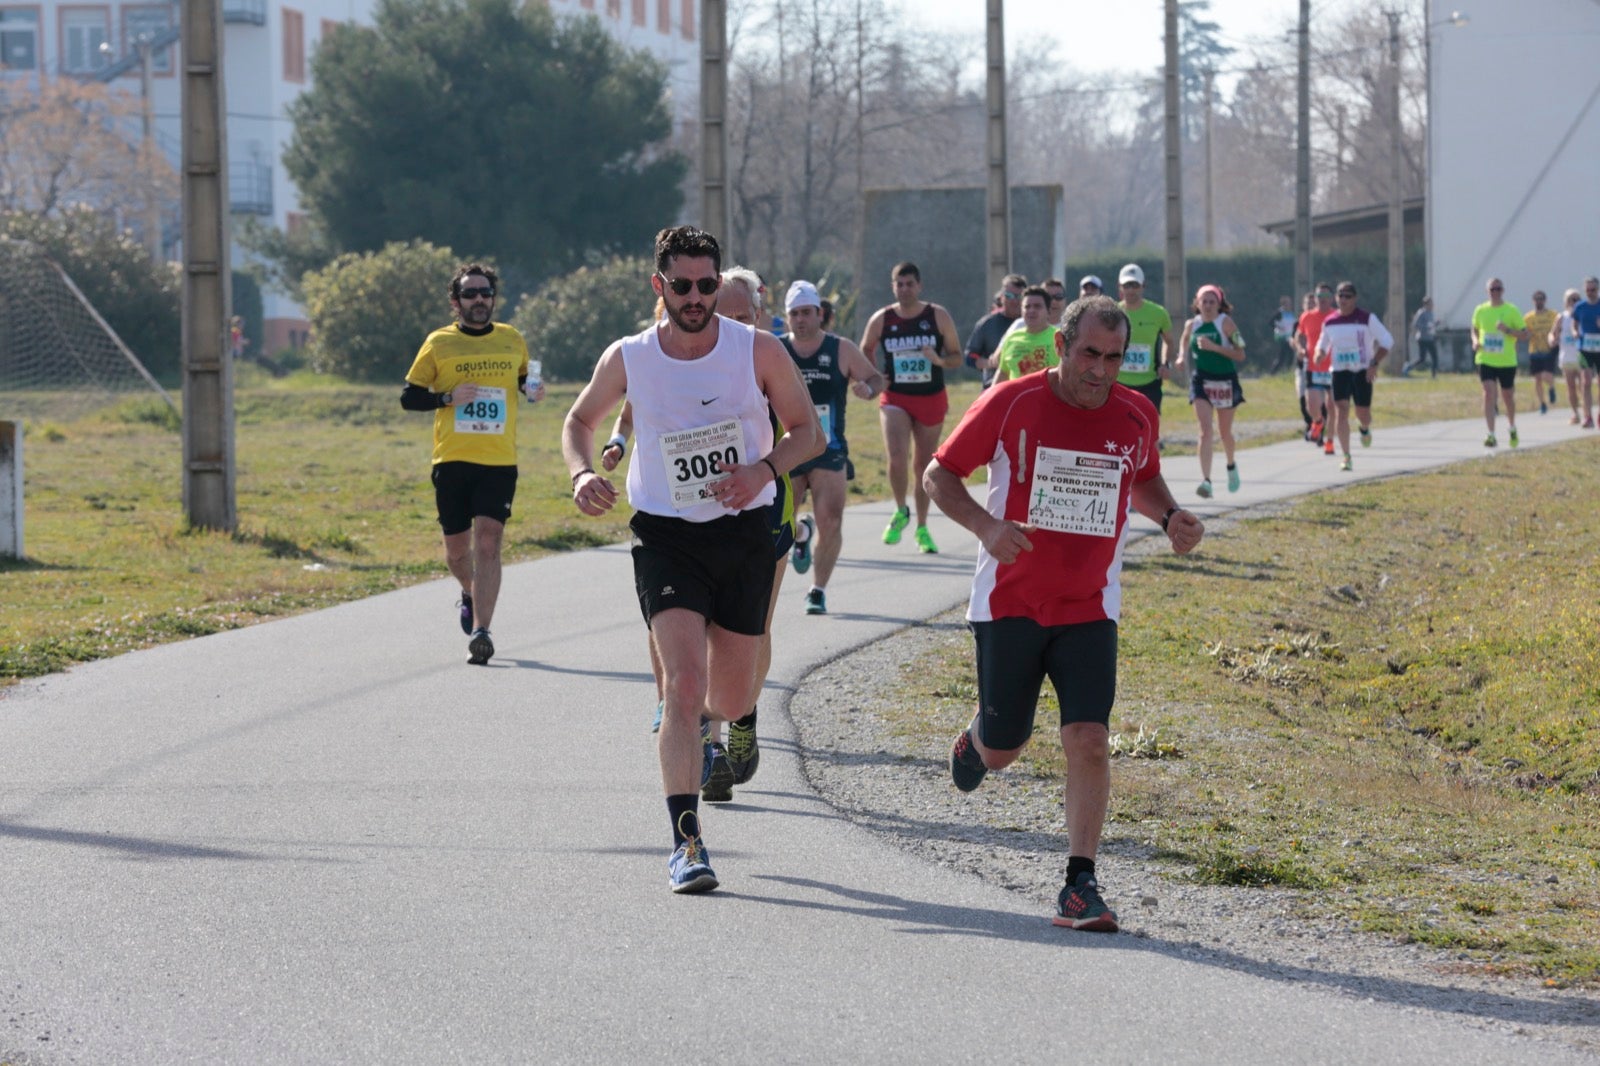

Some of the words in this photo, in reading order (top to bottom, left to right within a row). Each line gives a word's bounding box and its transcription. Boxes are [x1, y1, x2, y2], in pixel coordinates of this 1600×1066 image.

[884, 335, 937, 348] GRANADA
[455, 358, 513, 374] agustinos
[901, 360, 926, 373] 928
[463, 402, 499, 419] 489
[678, 433, 692, 441] GRAN
[693, 429, 712, 438] PREMIO
[720, 422, 736, 432] FONDO
[673, 446, 739, 482] 3080
[1051, 476, 1080, 485] CORRO
[1082, 480, 1117, 489] CONTRA
[1066, 487, 1100, 496] CANCER
[1084, 498, 1108, 524] 14
